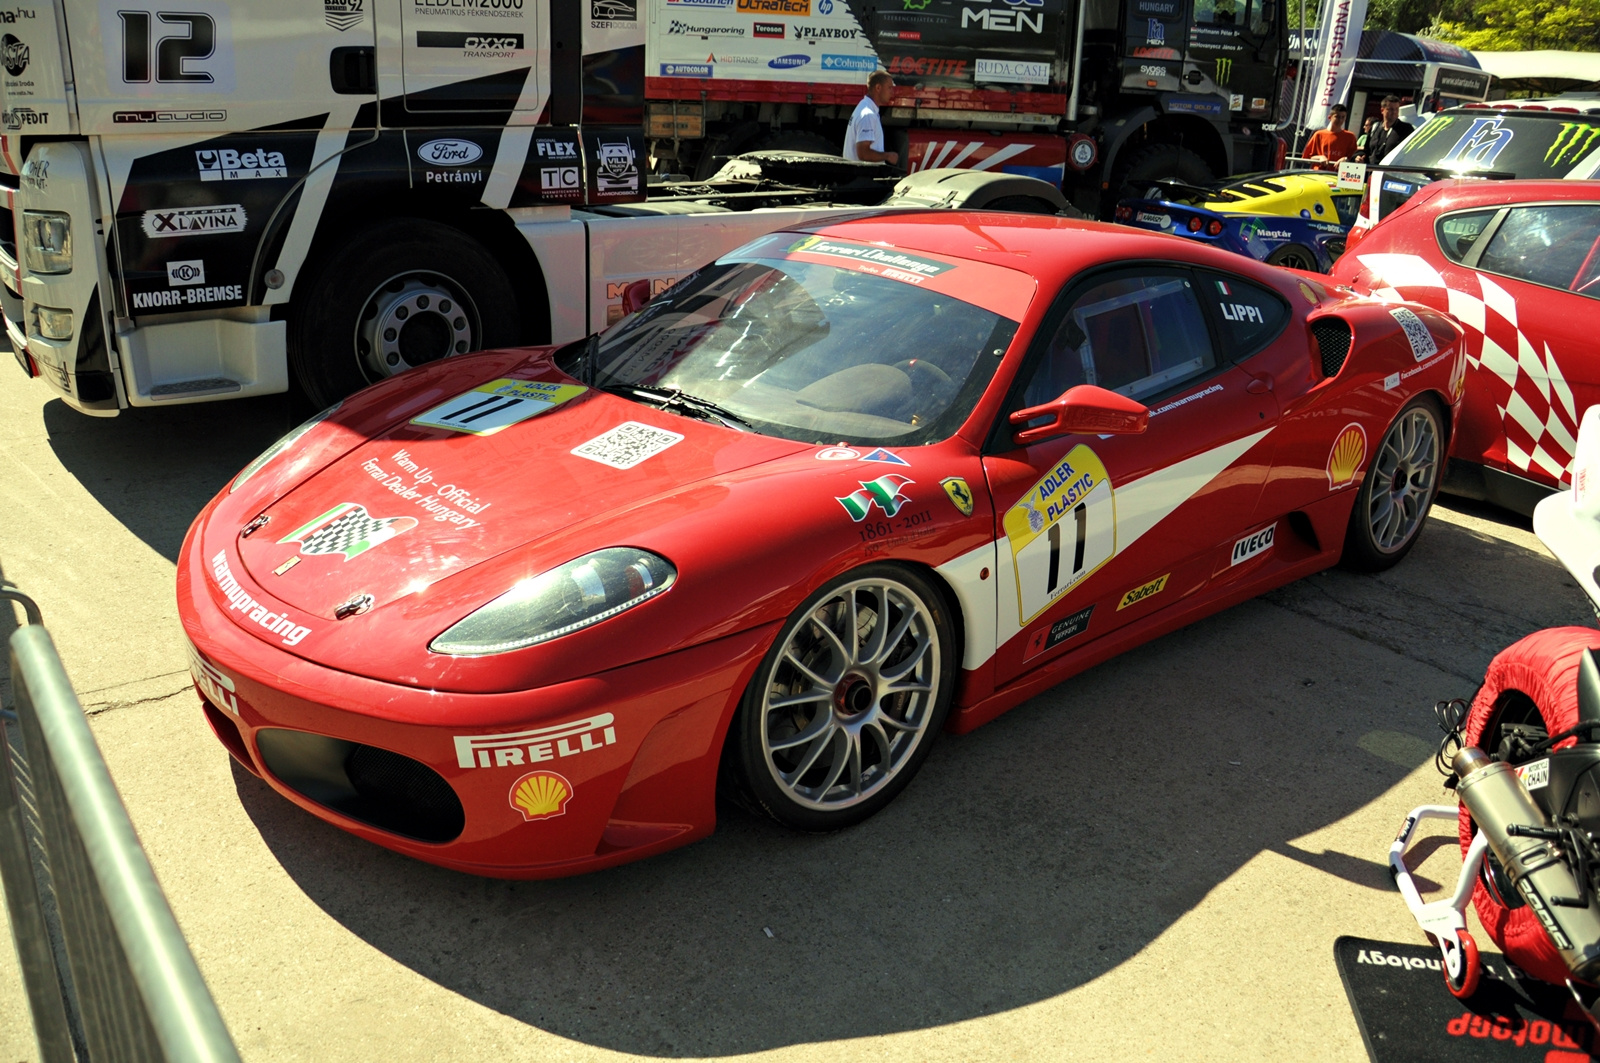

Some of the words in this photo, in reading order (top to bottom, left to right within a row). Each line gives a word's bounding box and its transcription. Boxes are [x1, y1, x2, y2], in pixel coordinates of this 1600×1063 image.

[414, 8, 466, 16] PNEUMATIKUS
[467, 9, 524, 18] FÉKRENDSZEREK
[1140, 2, 1175, 12] HUNGARY
[686, 25, 745, 35] Hungaroring
[961, 7, 1044, 34] MEN
[464, 37, 517, 49] OXXO
[804, 27, 857, 39] PLAYBOY
[117, 10, 216, 83] 12
[675, 66, 709, 74] AUTOCOLOR
[834, 58, 875, 69] Columbia
[889, 56, 968, 77] LOCTITE
[977, 61, 1048, 77] BUDA-CASH
[113, 110, 227, 123] myaudio
[220, 149, 286, 169] Beta
[431, 143, 469, 160] Ford
[536, 142, 577, 156] FLEX
[230, 169, 281, 178] MAX
[426, 170, 482, 183] Petrányi
[1346, 171, 1361, 179] Beta
[1256, 228, 1292, 239] Magtár
[132, 284, 243, 309] KNORR-BREMSE
[607, 278, 675, 299] MN
[1220, 302, 1264, 324] LIPPI
[507, 389, 556, 401] PLASTIC
[522, 383, 561, 392] ADLER
[440, 395, 525, 424] 11
[391, 449, 419, 473] Warm
[414, 468, 433, 485] Up
[437, 484, 491, 514] Official
[1039, 461, 1075, 501] ADLER
[361, 457, 395, 481] Ferrari
[382, 476, 422, 500] Dealer
[415, 495, 481, 530] Hungary
[1047, 473, 1094, 521] PLASTIC
[859, 522, 893, 542] 1861
[903, 510, 932, 528] 2011
[1047, 502, 1087, 594] 11
[1233, 526, 1275, 560] IVECO
[1050, 571, 1086, 600] Ferrari.com
[1123, 578, 1164, 606] Sabelt
[212, 549, 312, 646] warmupracing
[1051, 609, 1091, 634] GENUINE
[453, 712, 617, 768] PIRELLI
[1527, 769, 1548, 787] CHAIN
